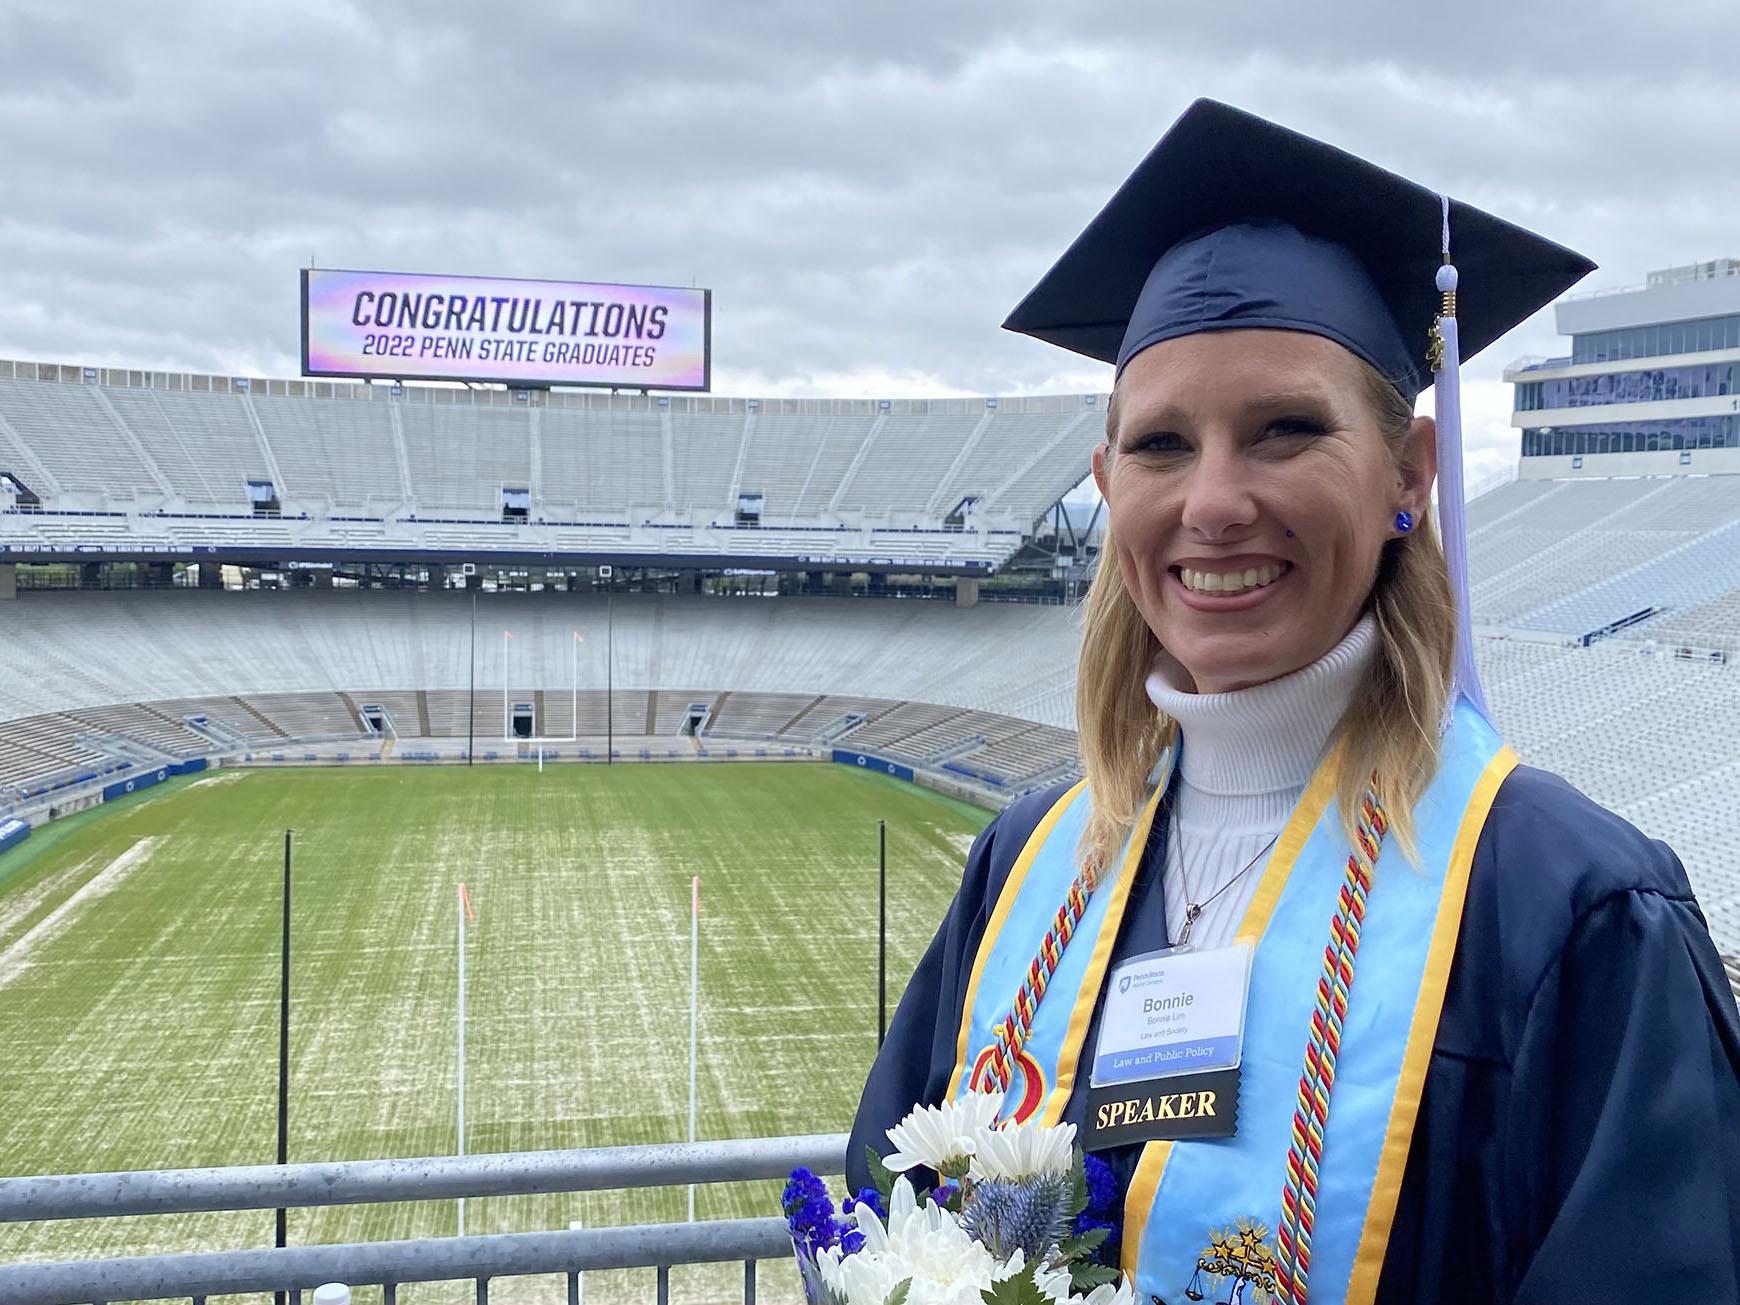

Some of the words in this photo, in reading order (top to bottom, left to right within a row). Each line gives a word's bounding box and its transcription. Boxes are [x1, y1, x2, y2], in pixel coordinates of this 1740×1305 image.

[352, 291, 670, 341] CONGRATULATIONS
[363, 334, 414, 357] 2022
[419, 336, 473, 360] PENN
[479, 338, 537, 363] STATE
[543, 342, 656, 368] GRADUATES
[1143, 992, 1194, 1013] Bonnie
[1147, 1014, 1170, 1025] Bonnie
[1113, 1057, 1132, 1069] Law
[1135, 1054, 1152, 1066] and
[1154, 1048, 1183, 1062] Public
[1186, 1045, 1215, 1058] Policy
[1096, 1091, 1216, 1130] SPEAKER
